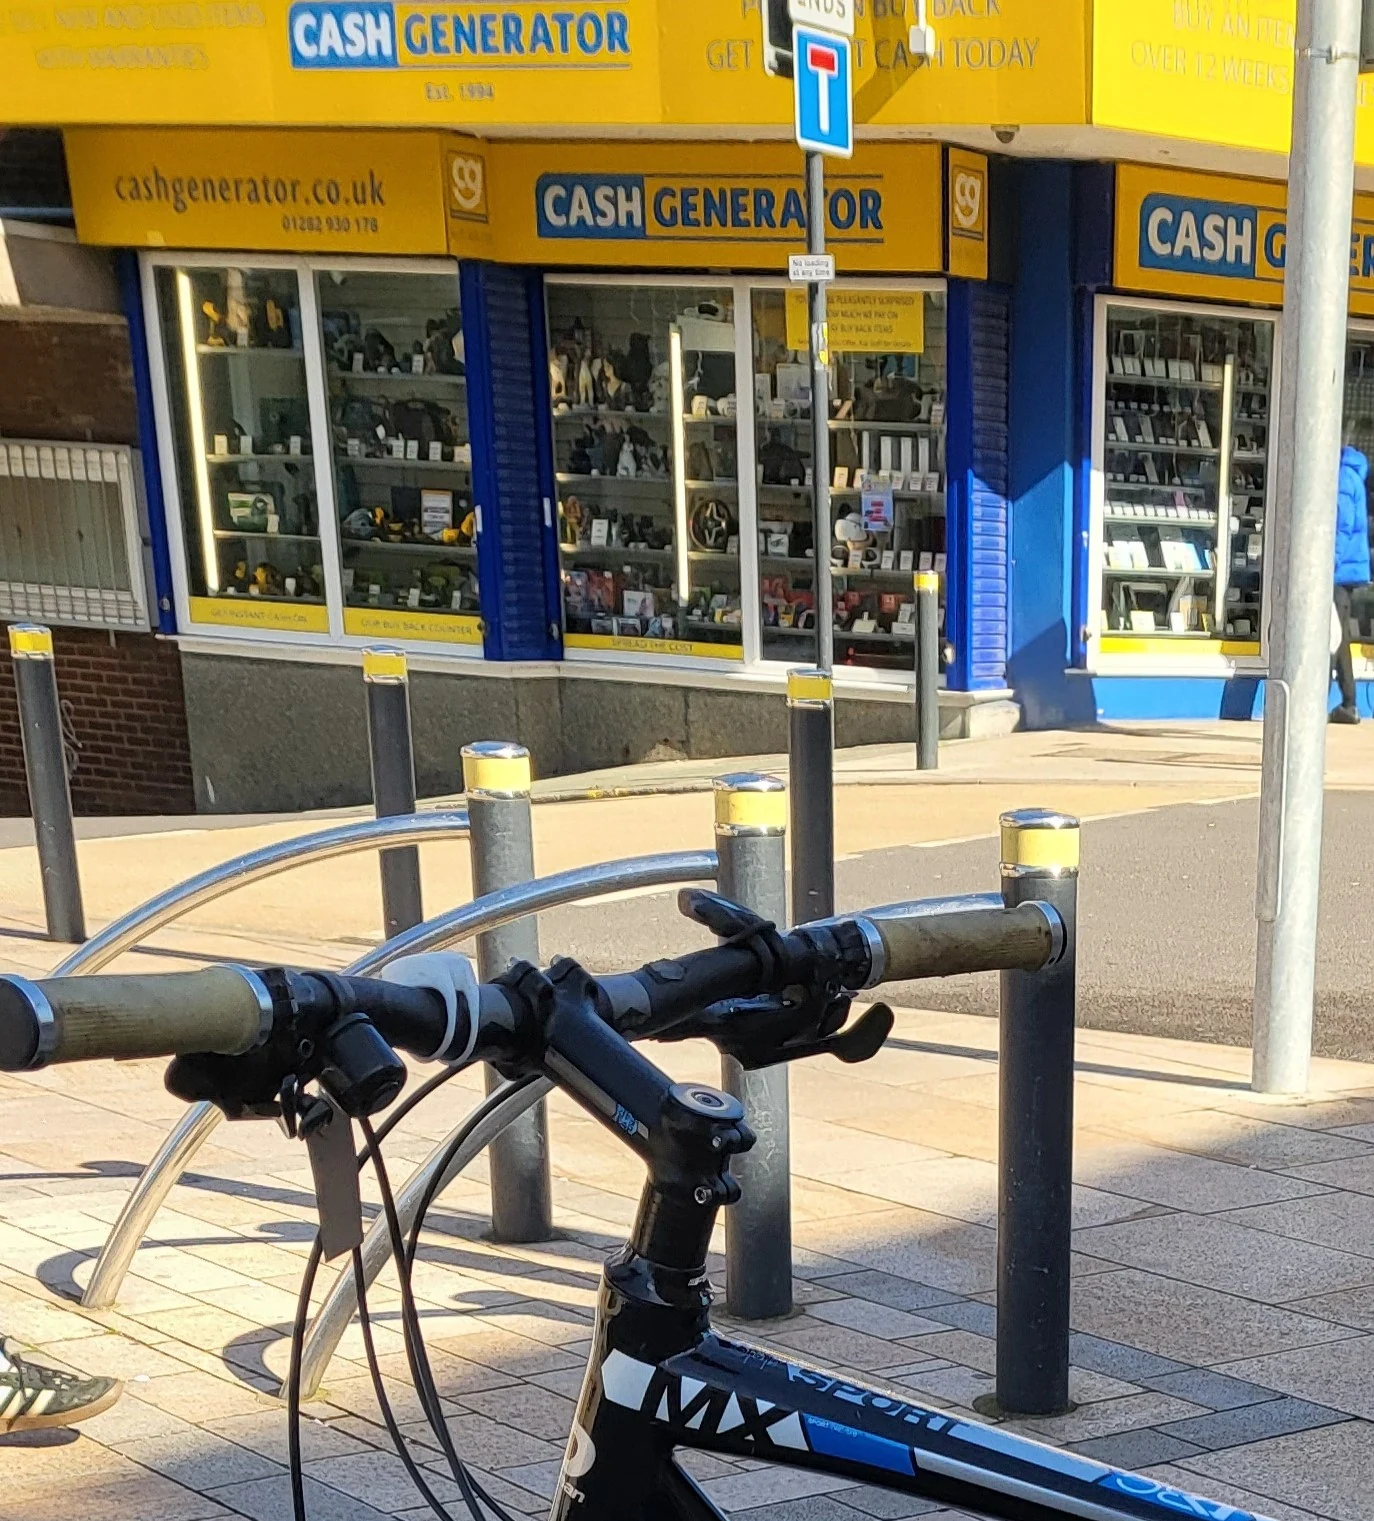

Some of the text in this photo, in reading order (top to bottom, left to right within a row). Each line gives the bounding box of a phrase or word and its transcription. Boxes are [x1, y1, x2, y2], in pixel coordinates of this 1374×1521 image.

[292, 11, 632, 58] CASH GENERATOR
[706, 39, 754, 71] GET
[875, 37, 945, 70] CAH
[952, 38, 1041, 71] TODAY
[1131, 39, 1188, 76] OVER
[1194, 52, 1217, 82] 12
[1222, 60, 1290, 96] WEEKS
[114, 165, 387, 214] cashgenerator.co.uk
[543, 184, 884, 231] CASH GENERAOR
[281, 214, 322, 232] 01282
[325, 215, 351, 233] 930
[1147, 206, 1252, 265] CASH
